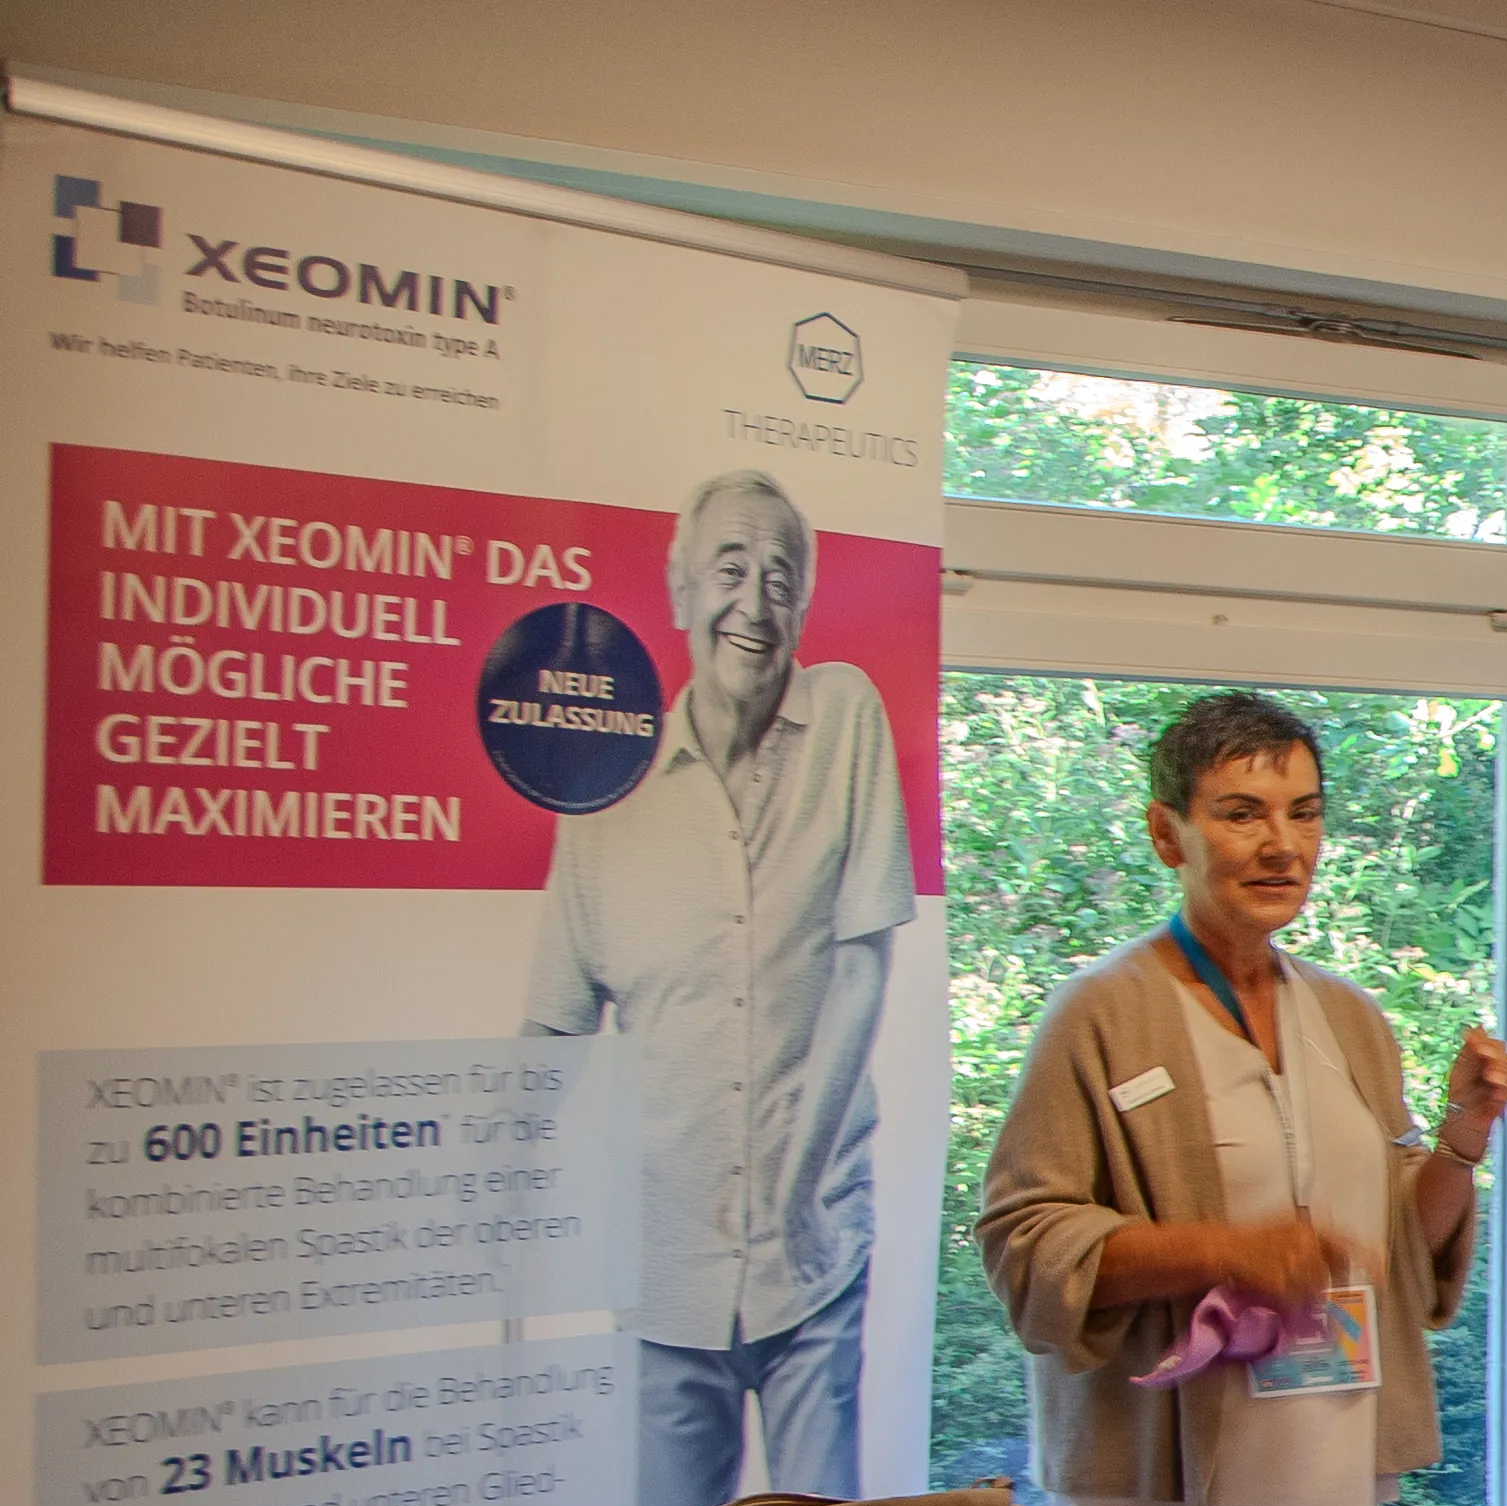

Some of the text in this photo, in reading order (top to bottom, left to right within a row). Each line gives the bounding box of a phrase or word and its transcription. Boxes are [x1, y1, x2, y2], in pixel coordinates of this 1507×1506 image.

[185, 233, 518, 325] XEOMIN®
[181, 291, 500, 360] Botulinum neurotoxin type A
[50, 331, 499, 410] Wir helfen Patienten, ihre Ziele zu erreichen
[796, 344, 854, 376] MERZ
[721, 408, 918, 467] THERAPEUTICS
[102, 500, 592, 592] MIT XEOMIN® DAS
[100, 572, 462, 647] INDIVIDUELL
[98, 632, 409, 709] MÖGLICHE
[538, 668, 615, 702] NEUE
[95, 714, 329, 771] GEZIELT
[488, 698, 654, 738] ZULASSUNG
[94, 785, 462, 843] MAXIMIEREN
[87, 1062, 564, 1109] XEOMIN® ist zugelassen für bis
[87, 1138, 130, 1165] zu
[144, 1123, 223, 1162] 600
[460, 1112, 509, 1145] für
[515, 1112, 558, 1142] die
[87, 1163, 562, 1219] kombinierte Behandlung einer
[86, 1212, 583, 1273] multifokalen Spastik der oberen
[85, 1294, 155, 1331] und
[163, 1284, 291, 1322] unteren
[83, 1364, 616, 1449] XEOMIN® kann für die Behandlung
[82, 1411, 584, 1505] von 23 Muskeln bei Spastik
[477, 1463, 566, 1502] Glied-
